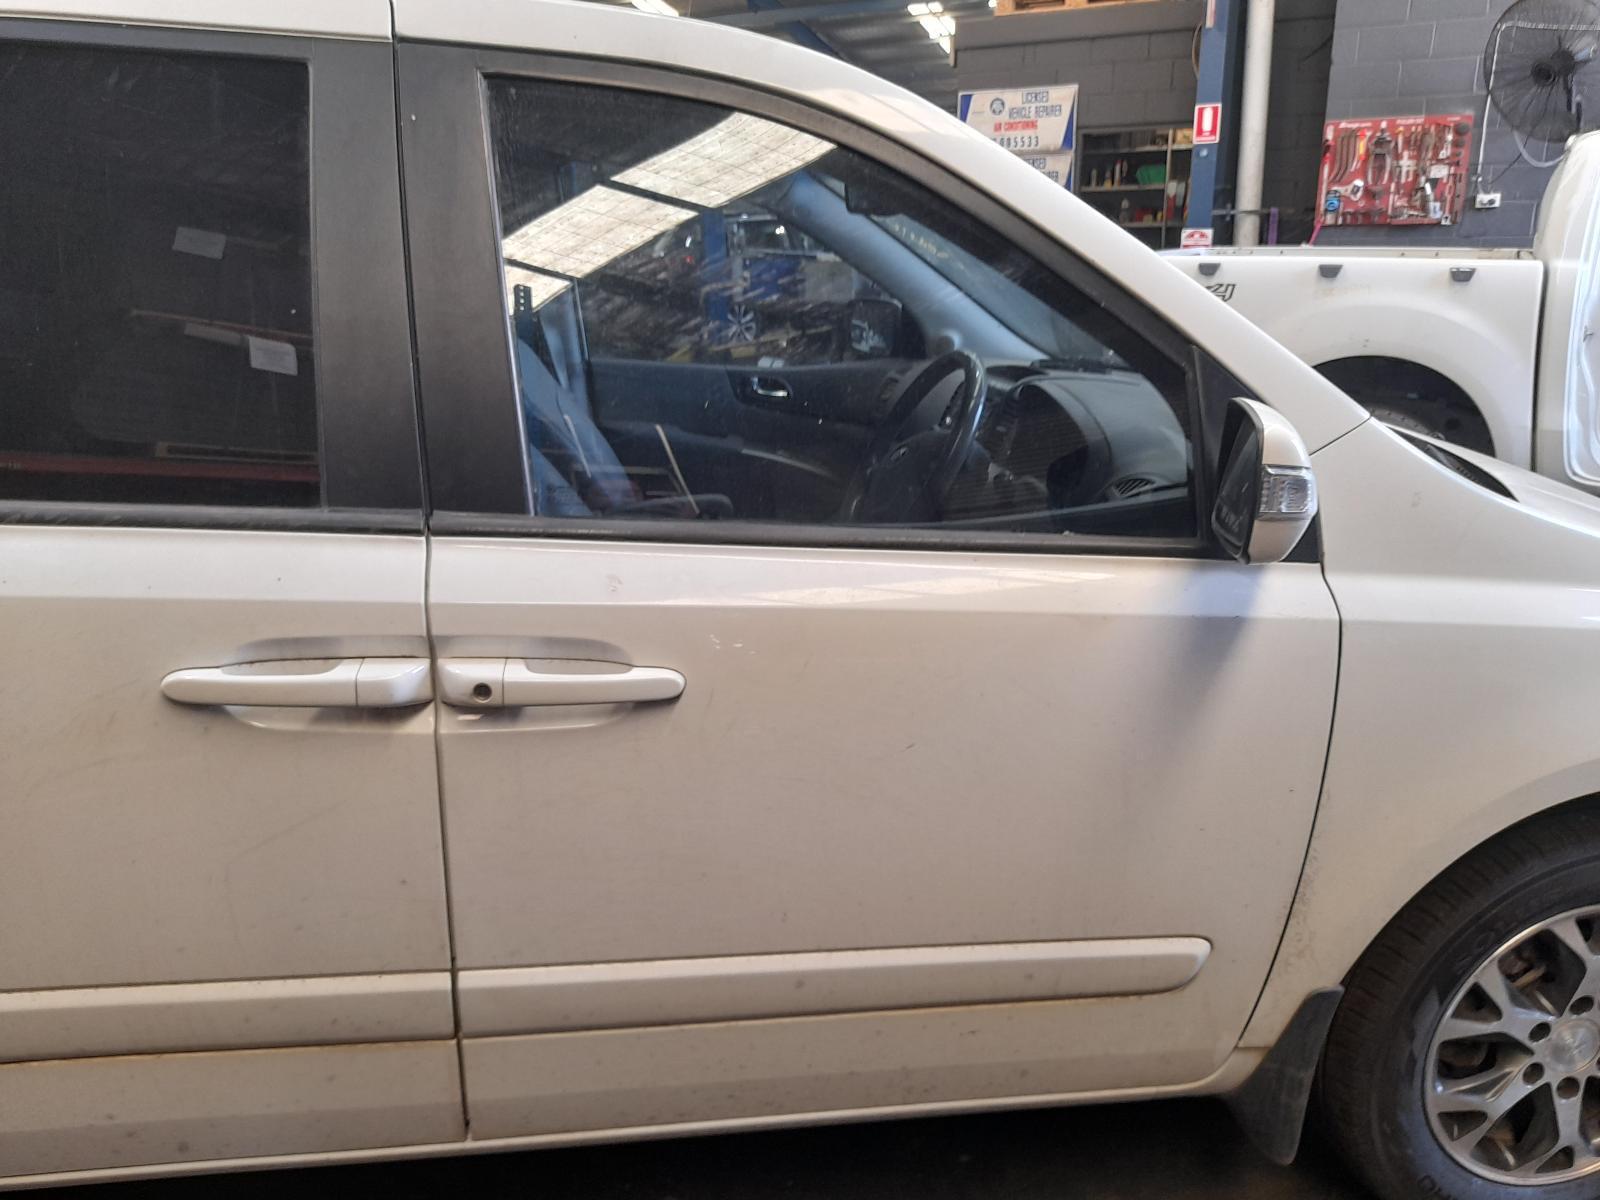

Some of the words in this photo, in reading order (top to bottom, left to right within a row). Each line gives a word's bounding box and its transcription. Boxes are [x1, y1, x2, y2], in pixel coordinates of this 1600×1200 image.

[1009, 107, 1032, 119] VEHICLE
[1035, 104, 1062, 118] REPAIRER
[1004, 120, 1037, 131] CONDITIONING
